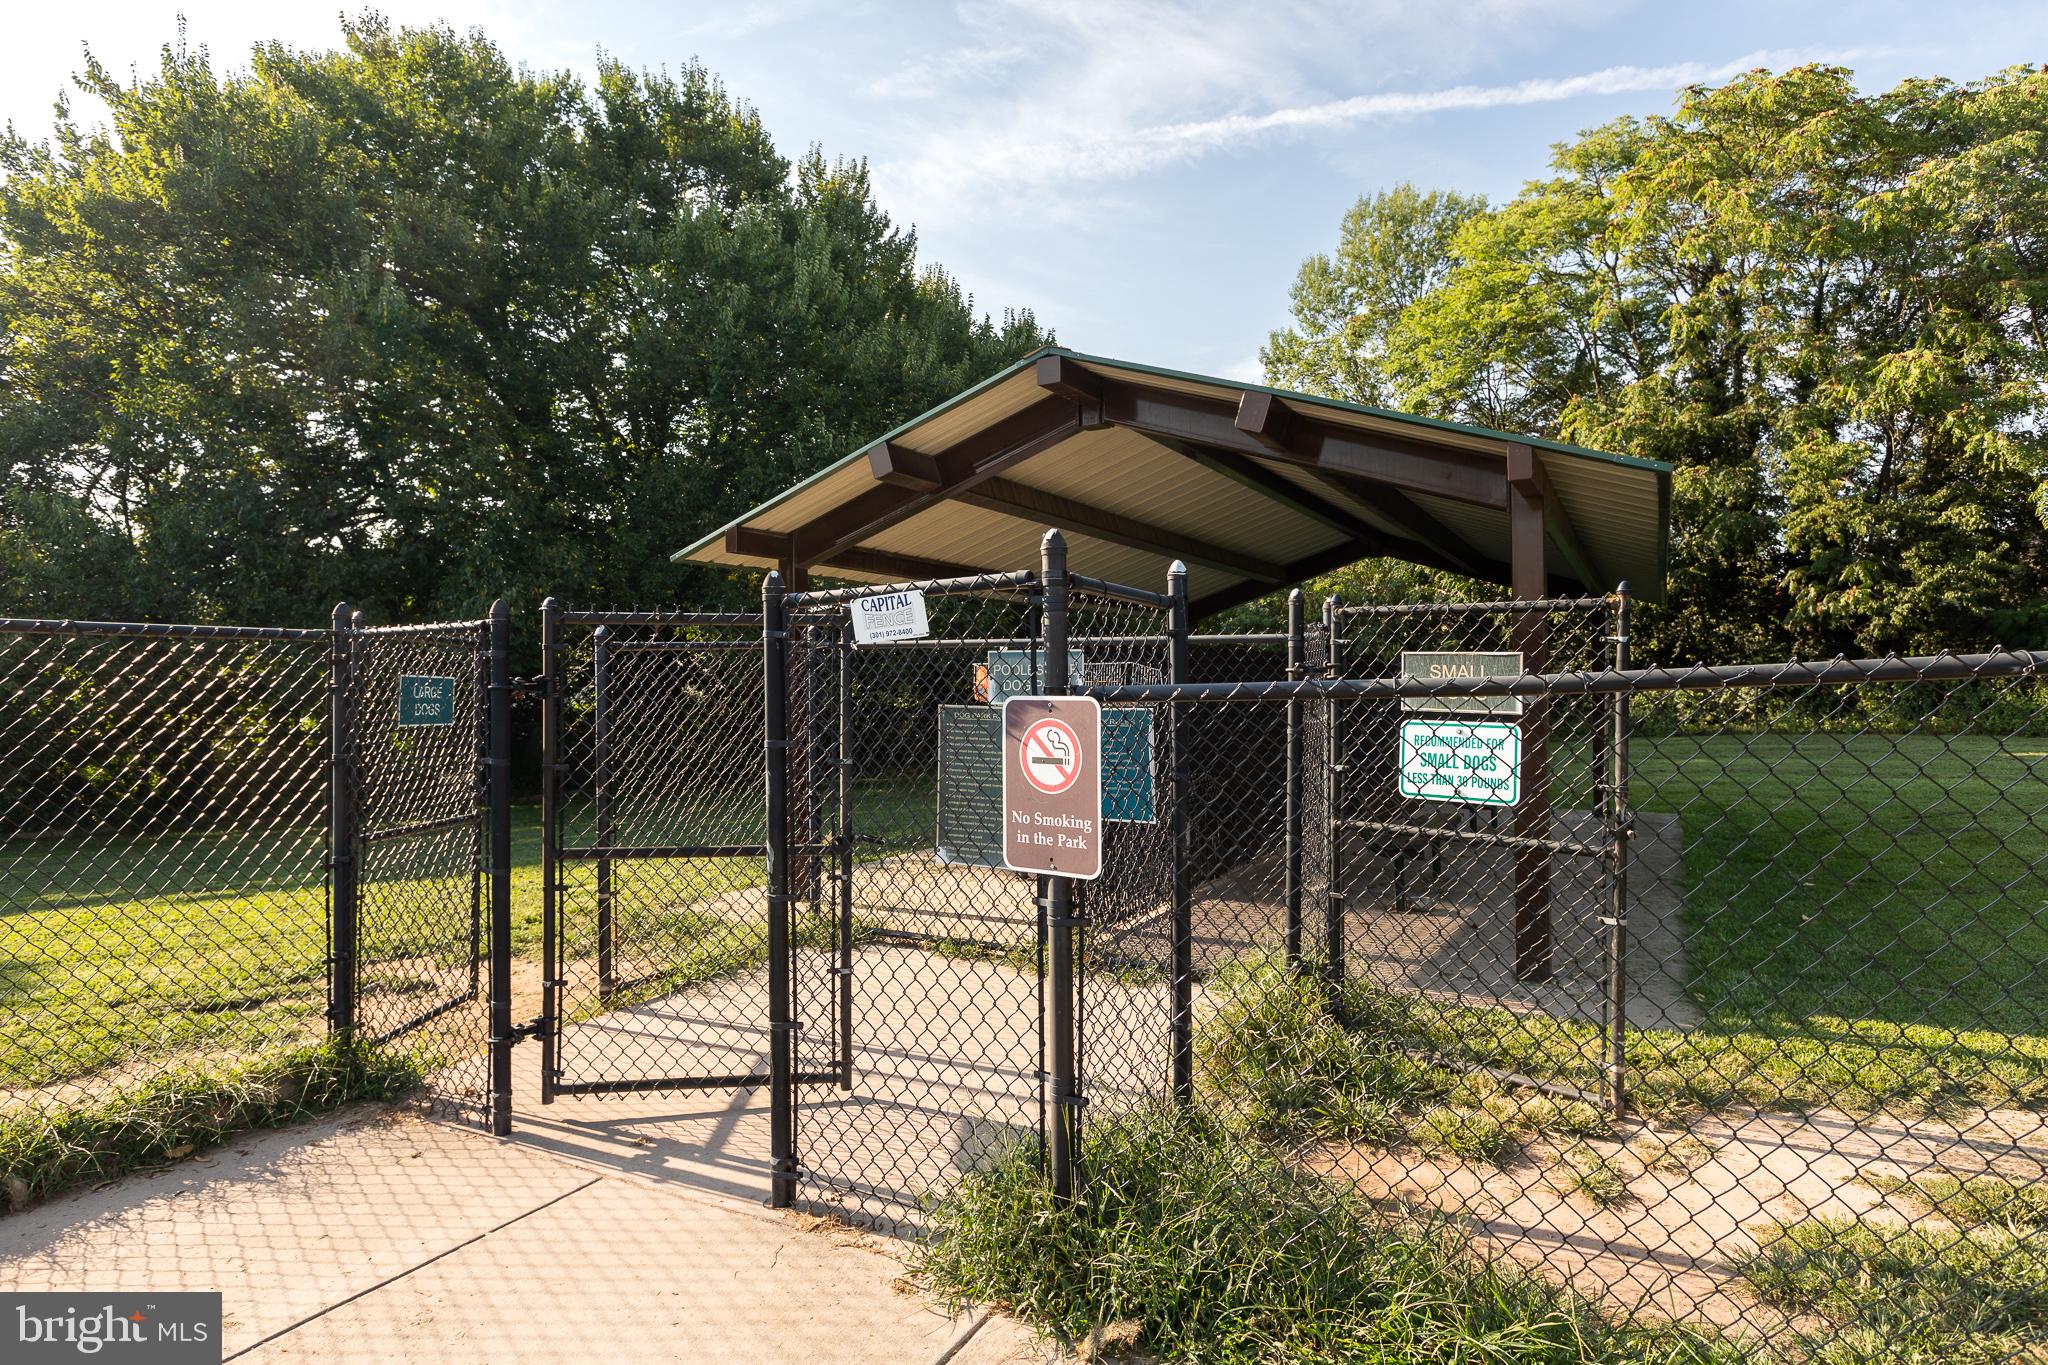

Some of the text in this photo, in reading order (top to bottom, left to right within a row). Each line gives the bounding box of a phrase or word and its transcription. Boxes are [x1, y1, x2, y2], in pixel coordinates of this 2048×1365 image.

[861, 594, 912, 612] CAPITAL
[864, 608, 914, 630] FENCE
[869, 631, 885, 641] (301)
[1003, 680, 1031, 691] DOG
[415, 703, 440, 715] DOGS
[1414, 735, 1505, 751] RECOMMENDED FOR
[1420, 752, 1497, 772] SMALL DOGS
[1407, 772, 1510, 791] LESS THAN 30 POUNDS
[1011, 810, 1093, 833] No Smoking
[1017, 830, 1088, 850] in the Park
